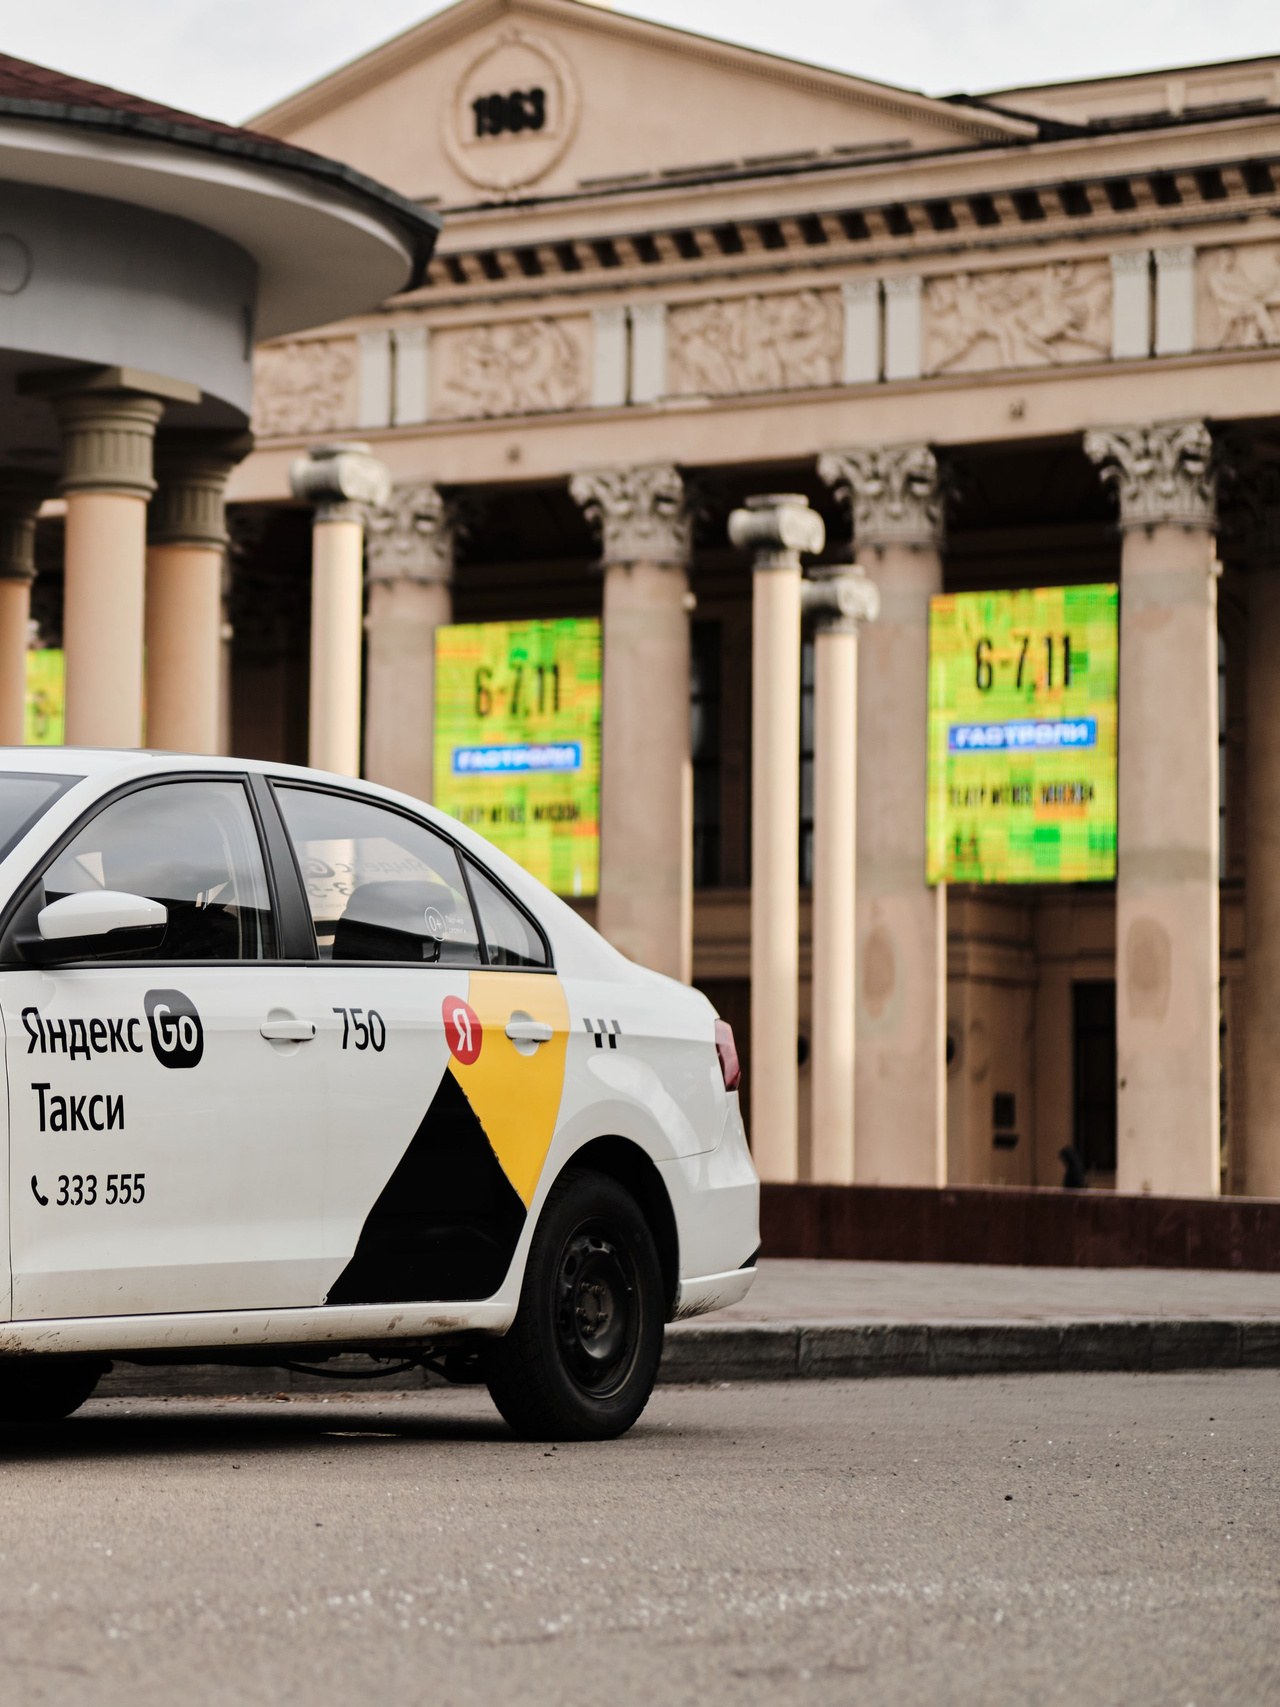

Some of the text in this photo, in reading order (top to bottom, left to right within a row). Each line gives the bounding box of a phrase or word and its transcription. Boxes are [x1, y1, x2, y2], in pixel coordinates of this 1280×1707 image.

[21, 1004, 198, 1061] Яндекс Go
[332, 1007, 386, 1053] 750
[31, 1082, 125, 1132] Такси
[56, 1173, 146, 1206] 333 555
